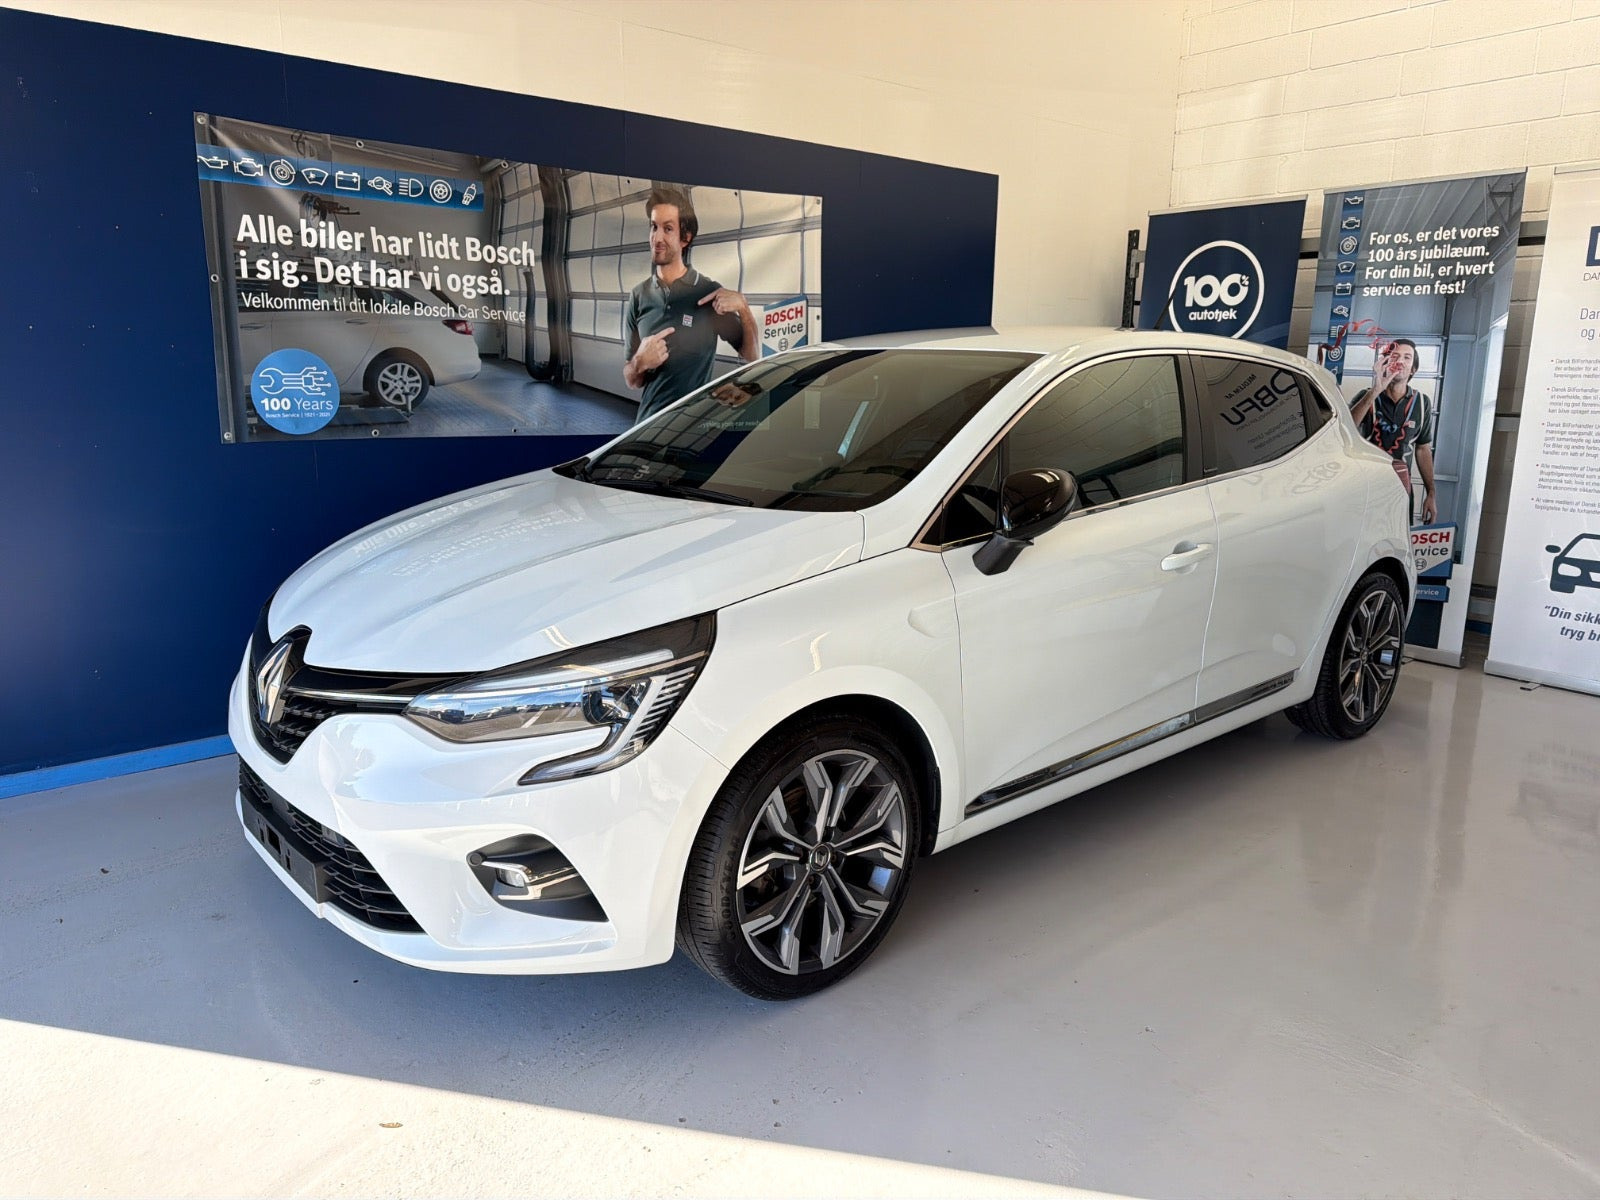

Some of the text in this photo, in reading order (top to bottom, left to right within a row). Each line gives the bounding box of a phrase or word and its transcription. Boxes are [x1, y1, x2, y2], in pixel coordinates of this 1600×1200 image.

[236, 213, 536, 267] Alle biler har lidt Bosch
[1369, 225, 1500, 246] For os, er det vores
[1368, 243, 1490, 263] 100 års jubilæum.
[239, 249, 510, 300] i sig. Det har vi også.
[1365, 260, 1495, 280] For din bil, er hvert
[1362, 279, 1467, 298] service en fest!
[241, 291, 527, 321] Velkommen til dit lokale Bosch Car Service
[1188, 308, 1239, 322] autotjek
[765, 305, 804, 326] BOSCH
[763, 322, 804, 340] Service
[1580, 328, 1596, 341] og
[260, 397, 334, 411] 100 Years
[1410, 532, 1451, 545] OSCH
[1414, 545, 1449, 556] rvice
[1415, 588, 1440, 596] ervice
[1560, 626, 1585, 641] tryg
